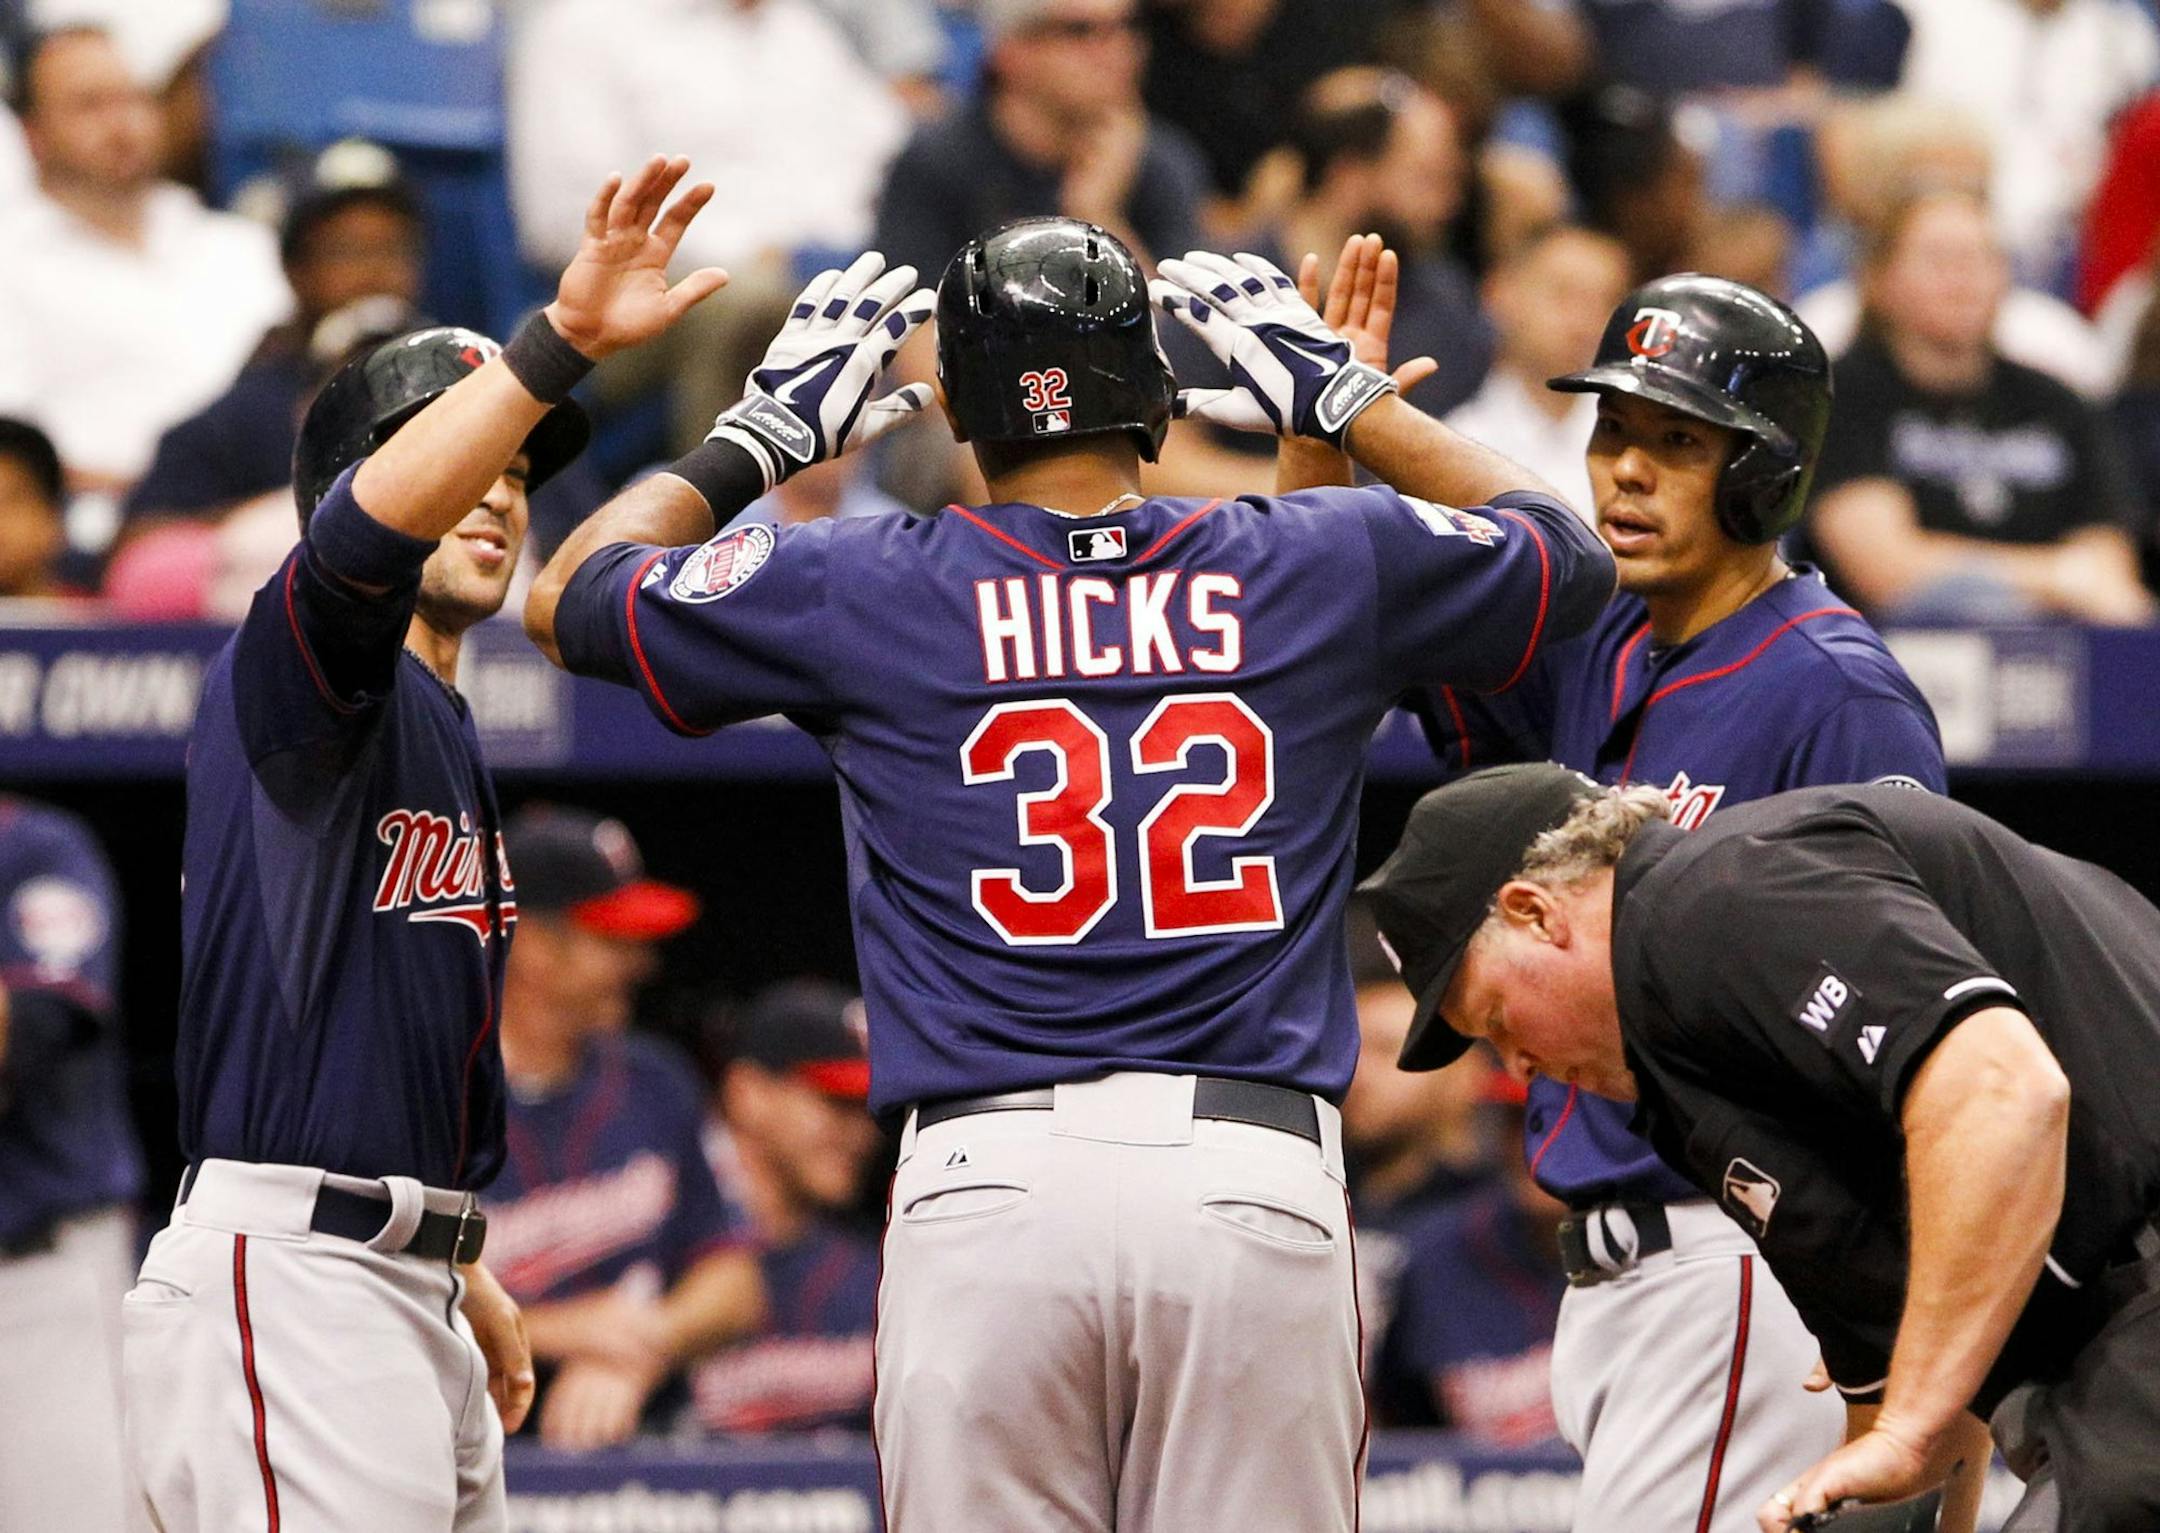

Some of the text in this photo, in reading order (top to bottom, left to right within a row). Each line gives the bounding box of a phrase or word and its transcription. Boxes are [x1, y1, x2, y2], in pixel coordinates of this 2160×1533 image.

[1019, 366, 1072, 412] 32
[973, 569, 1244, 684] HICKS
[959, 692, 1285, 946] 32
[1799, 974, 1849, 1033] WB
